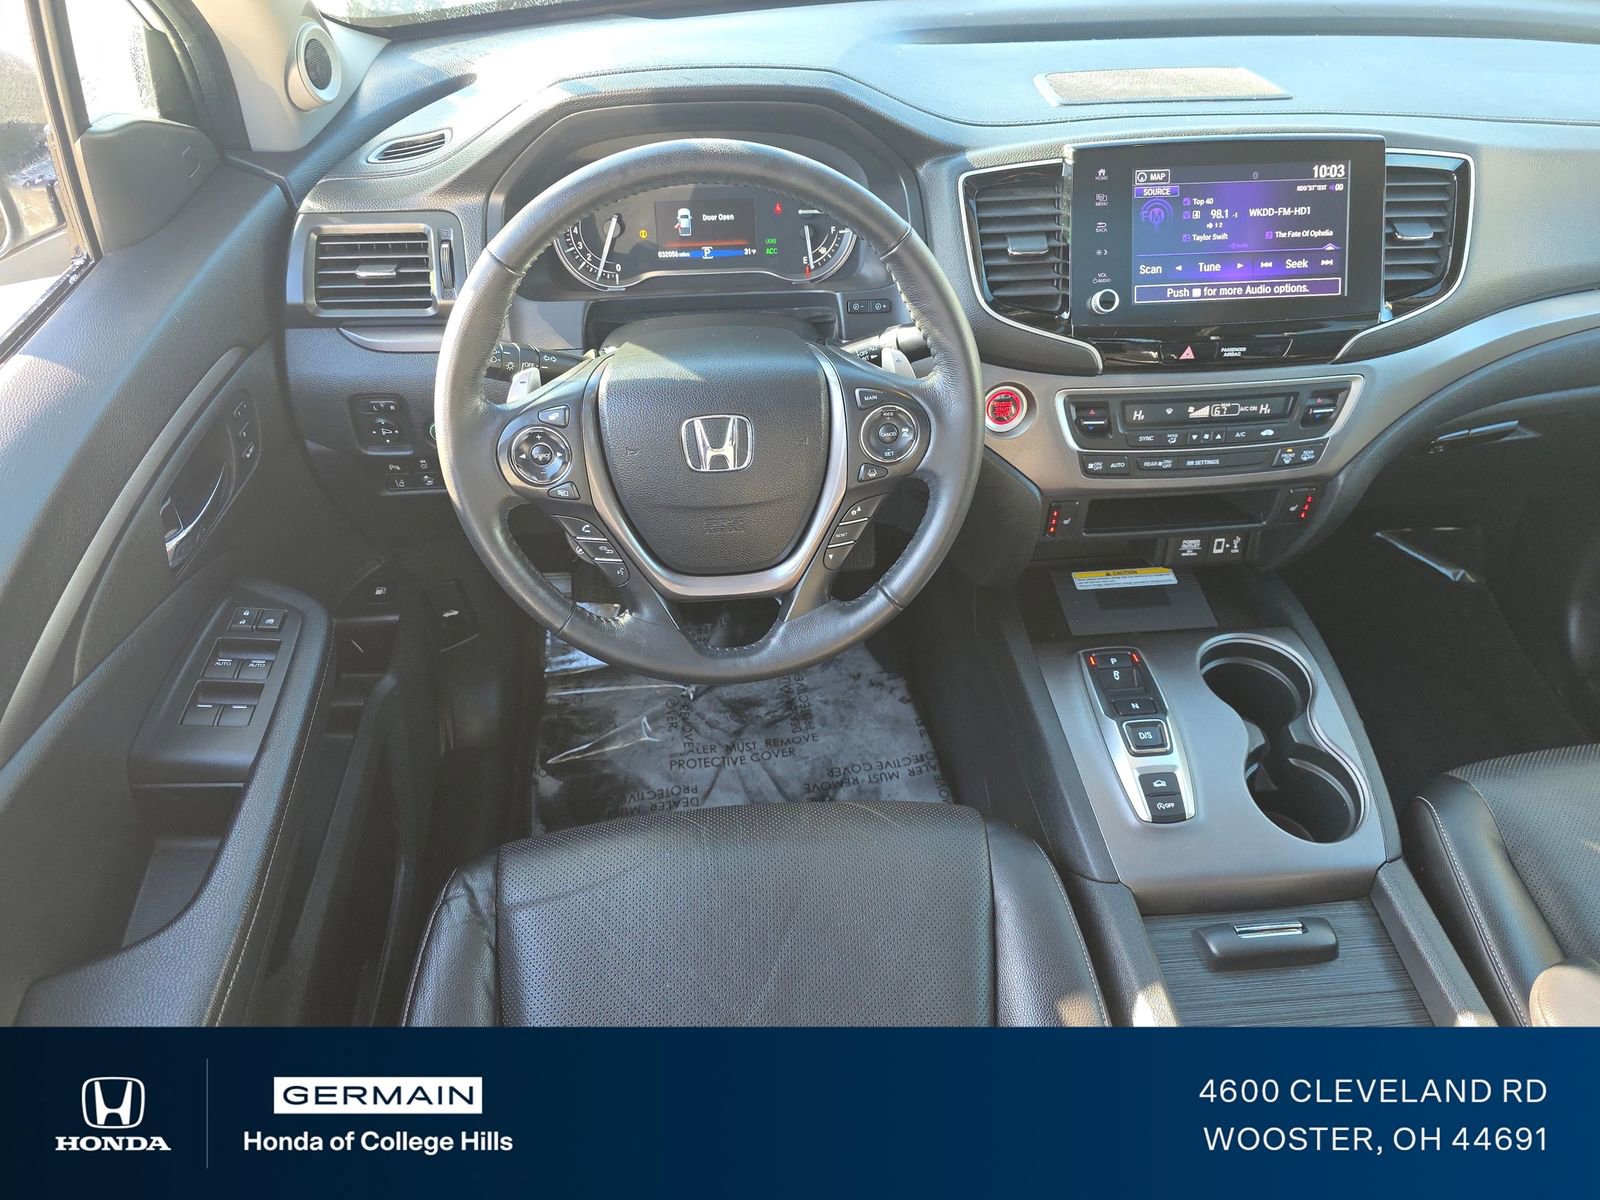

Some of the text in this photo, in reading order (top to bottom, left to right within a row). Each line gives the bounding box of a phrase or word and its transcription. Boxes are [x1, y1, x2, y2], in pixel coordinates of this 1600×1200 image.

[1312, 164, 1345, 178] 10:03
[1149, 173, 1166, 181] MAP
[1143, 187, 1171, 196] SOURCE
[1193, 198, 1204, 206] Top
[1210, 209, 1229, 219] 98.1
[1249, 207, 1311, 217] WKDD-FM-HD1
[718, 213, 734, 221] Open
[831, 226, 836, 234] F
[1310, 229, 1333, 238] Ophelia
[1192, 233, 1228, 242] Taylor Swift
[578, 241, 583, 250] 3
[587, 253, 592, 261] 2
[803, 256, 808, 264] E
[616, 263, 621, 272] 0
[1139, 258, 1308, 274] Scan Tune Seek
[1167, 284, 1309, 298] Push for more Audio options.
[725, 741, 757, 753] MUST
[764, 733, 819, 748] REMOVE
[669, 747, 797, 770] PROTECTIVE COVER
[826, 762, 873, 777] COVER
[804, 763, 937, 794] ALER MUST REMOVE
